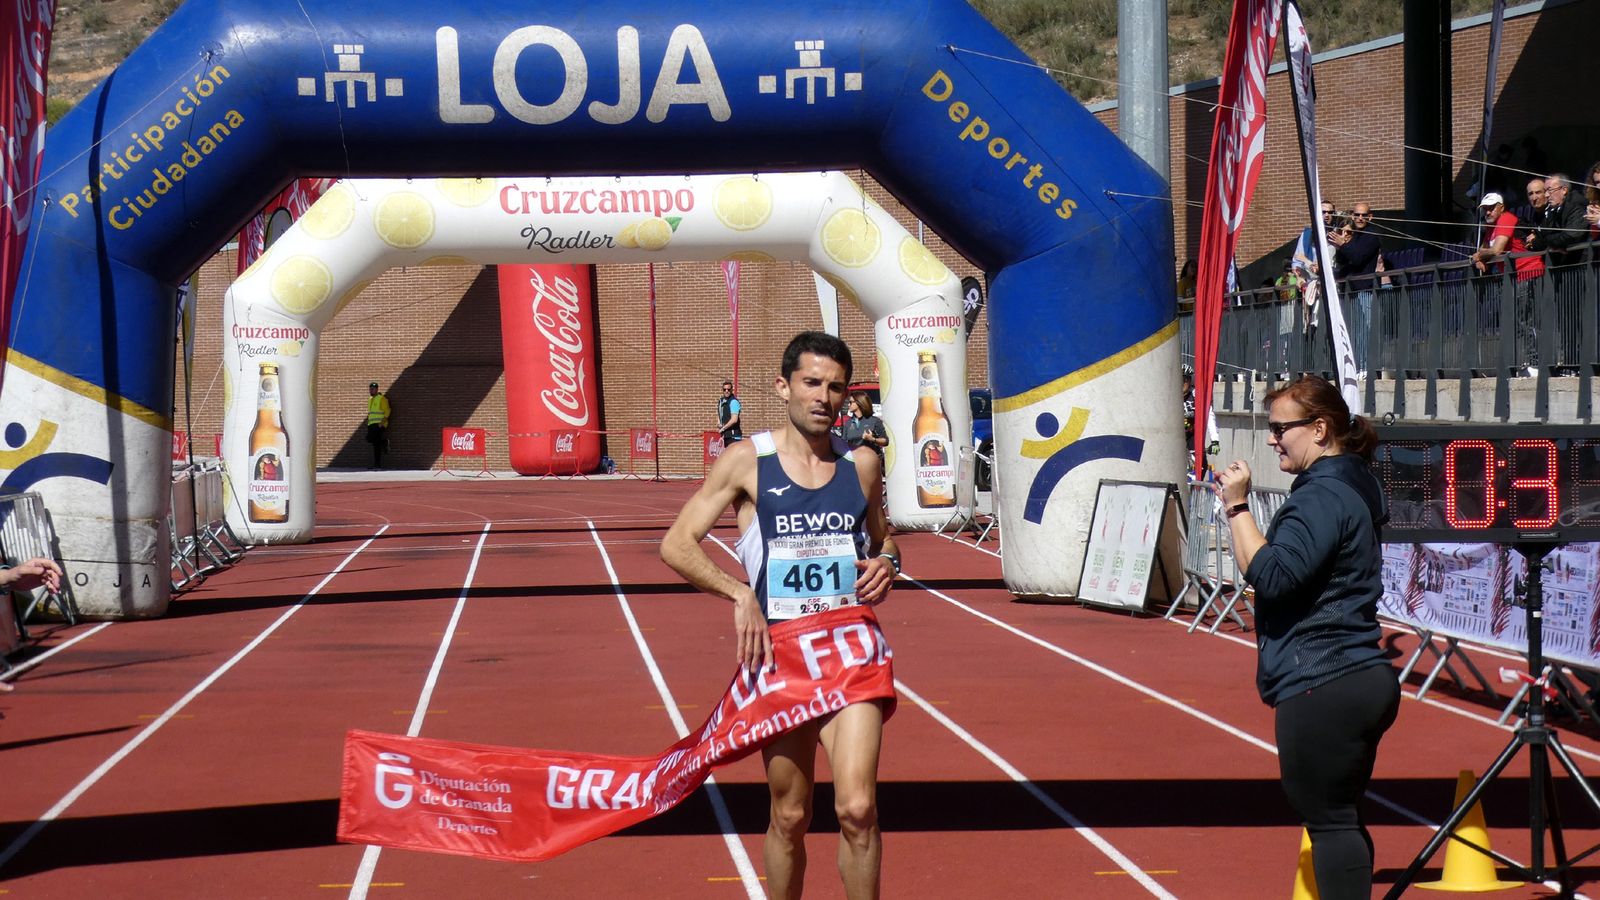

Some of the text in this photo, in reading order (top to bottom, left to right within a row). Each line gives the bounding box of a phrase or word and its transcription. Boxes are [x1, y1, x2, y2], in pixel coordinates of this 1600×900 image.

[436, 24, 732, 124] LOJA
[59, 65, 231, 218] Participación
[921, 69, 1078, 220] Deportes
[108, 109, 245, 230] Ciudadana
[500, 184, 695, 217] Cruzcampo
[520, 224, 616, 254] Radler
[232, 324, 309, 341] Cruzcampo
[888, 315, 961, 329] Cruzcampo
[238, 343, 278, 358] Radler
[895, 333, 935, 347] Radler
[74, 572, 152, 588] OJA
[783, 561, 841, 593] 461
[704, 737, 726, 763] de
[728, 686, 850, 751] Granada
[419, 770, 512, 793] Diputación
[419, 789, 513, 813] de Granada
[437, 816, 498, 836] Deportes
